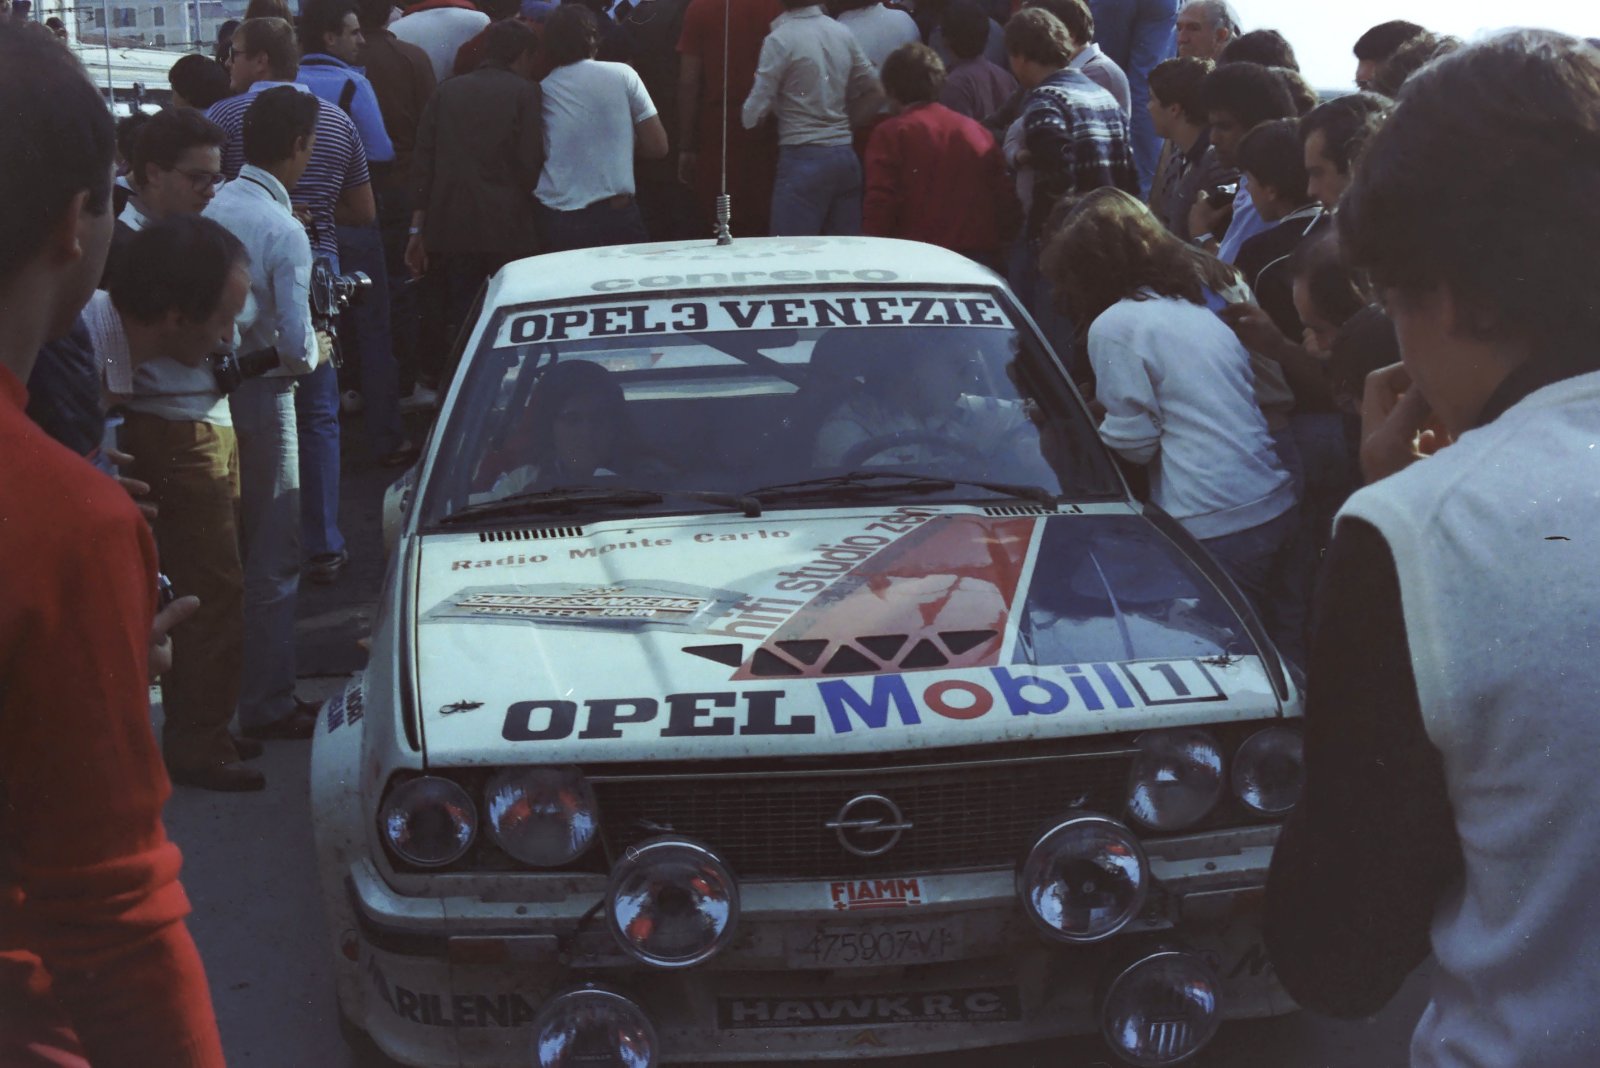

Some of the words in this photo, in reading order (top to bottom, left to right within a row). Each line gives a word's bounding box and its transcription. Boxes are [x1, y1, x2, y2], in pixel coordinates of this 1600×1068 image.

[589, 269, 900, 292] conrero
[509, 304, 667, 345] OPEL
[671, 302, 708, 332] 3
[718, 297, 1004, 330] VENEZIE
[451, 551, 549, 572] Radio
[568, 536, 673, 560] Monte
[693, 529, 791, 544] Carlo
[703, 595, 806, 640] hifi
[774, 534, 892, 594] studio
[501, 690, 816, 743] OPEL
[816, 662, 1136, 735] Mobil
[1148, 664, 1192, 697] 1
[830, 879, 921, 902] FIAMM
[731, 996, 913, 1022] HAWK
